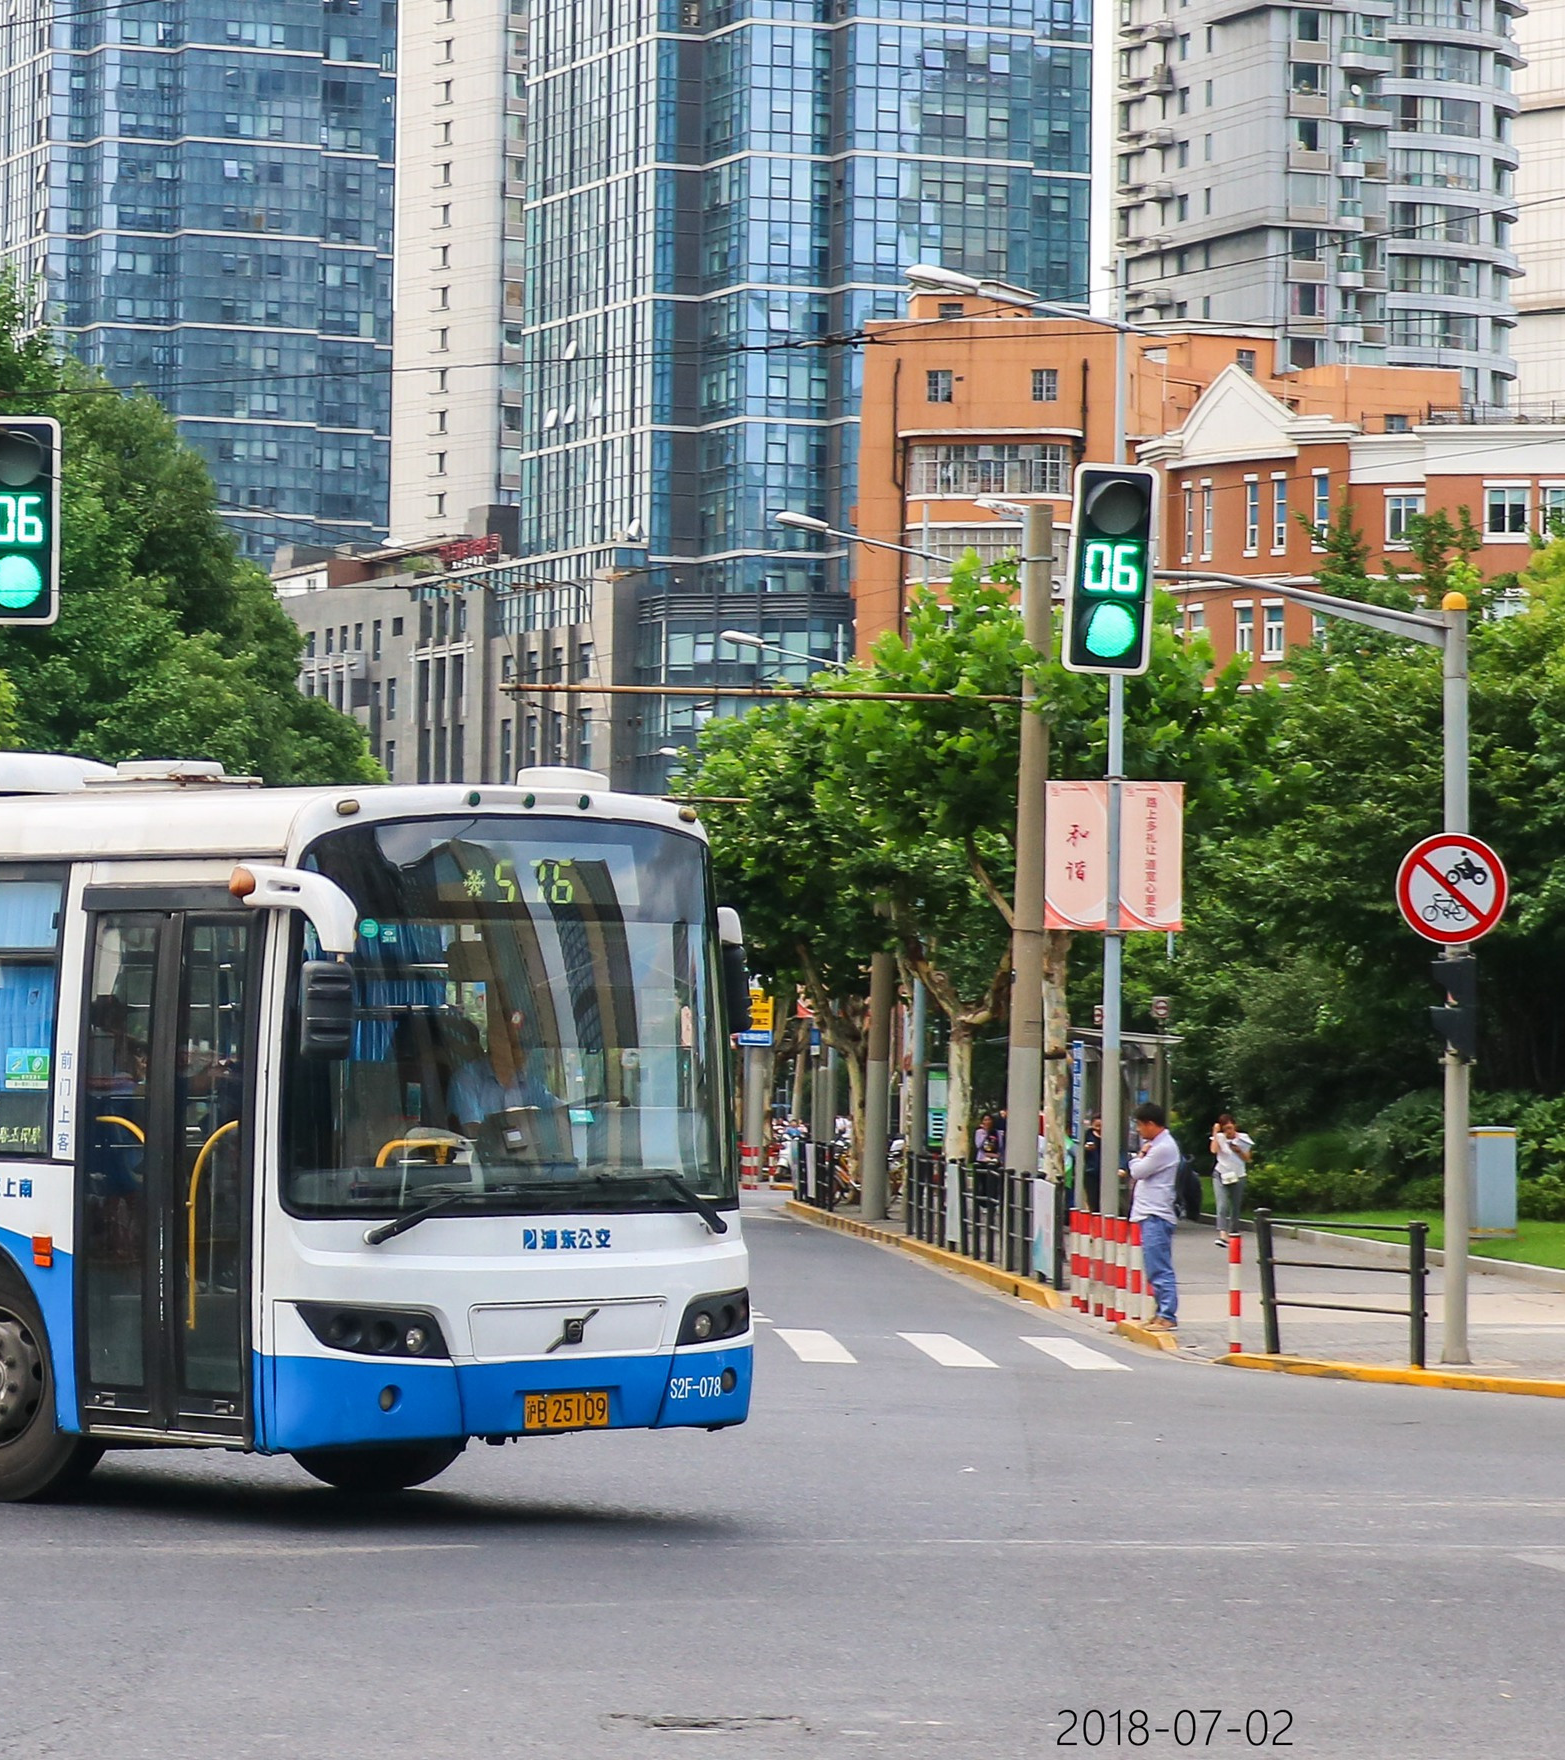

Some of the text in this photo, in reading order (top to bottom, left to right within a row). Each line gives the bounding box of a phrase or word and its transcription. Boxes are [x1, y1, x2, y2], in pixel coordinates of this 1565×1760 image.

[1083, 543, 1139, 593] 06
[1065, 823, 1091, 882] 和谐
[57, 1050, 73, 1152] 前门上客
[540, 1228, 612, 1250] 浦东公交
[669, 1375, 722, 1400] S2F-078
